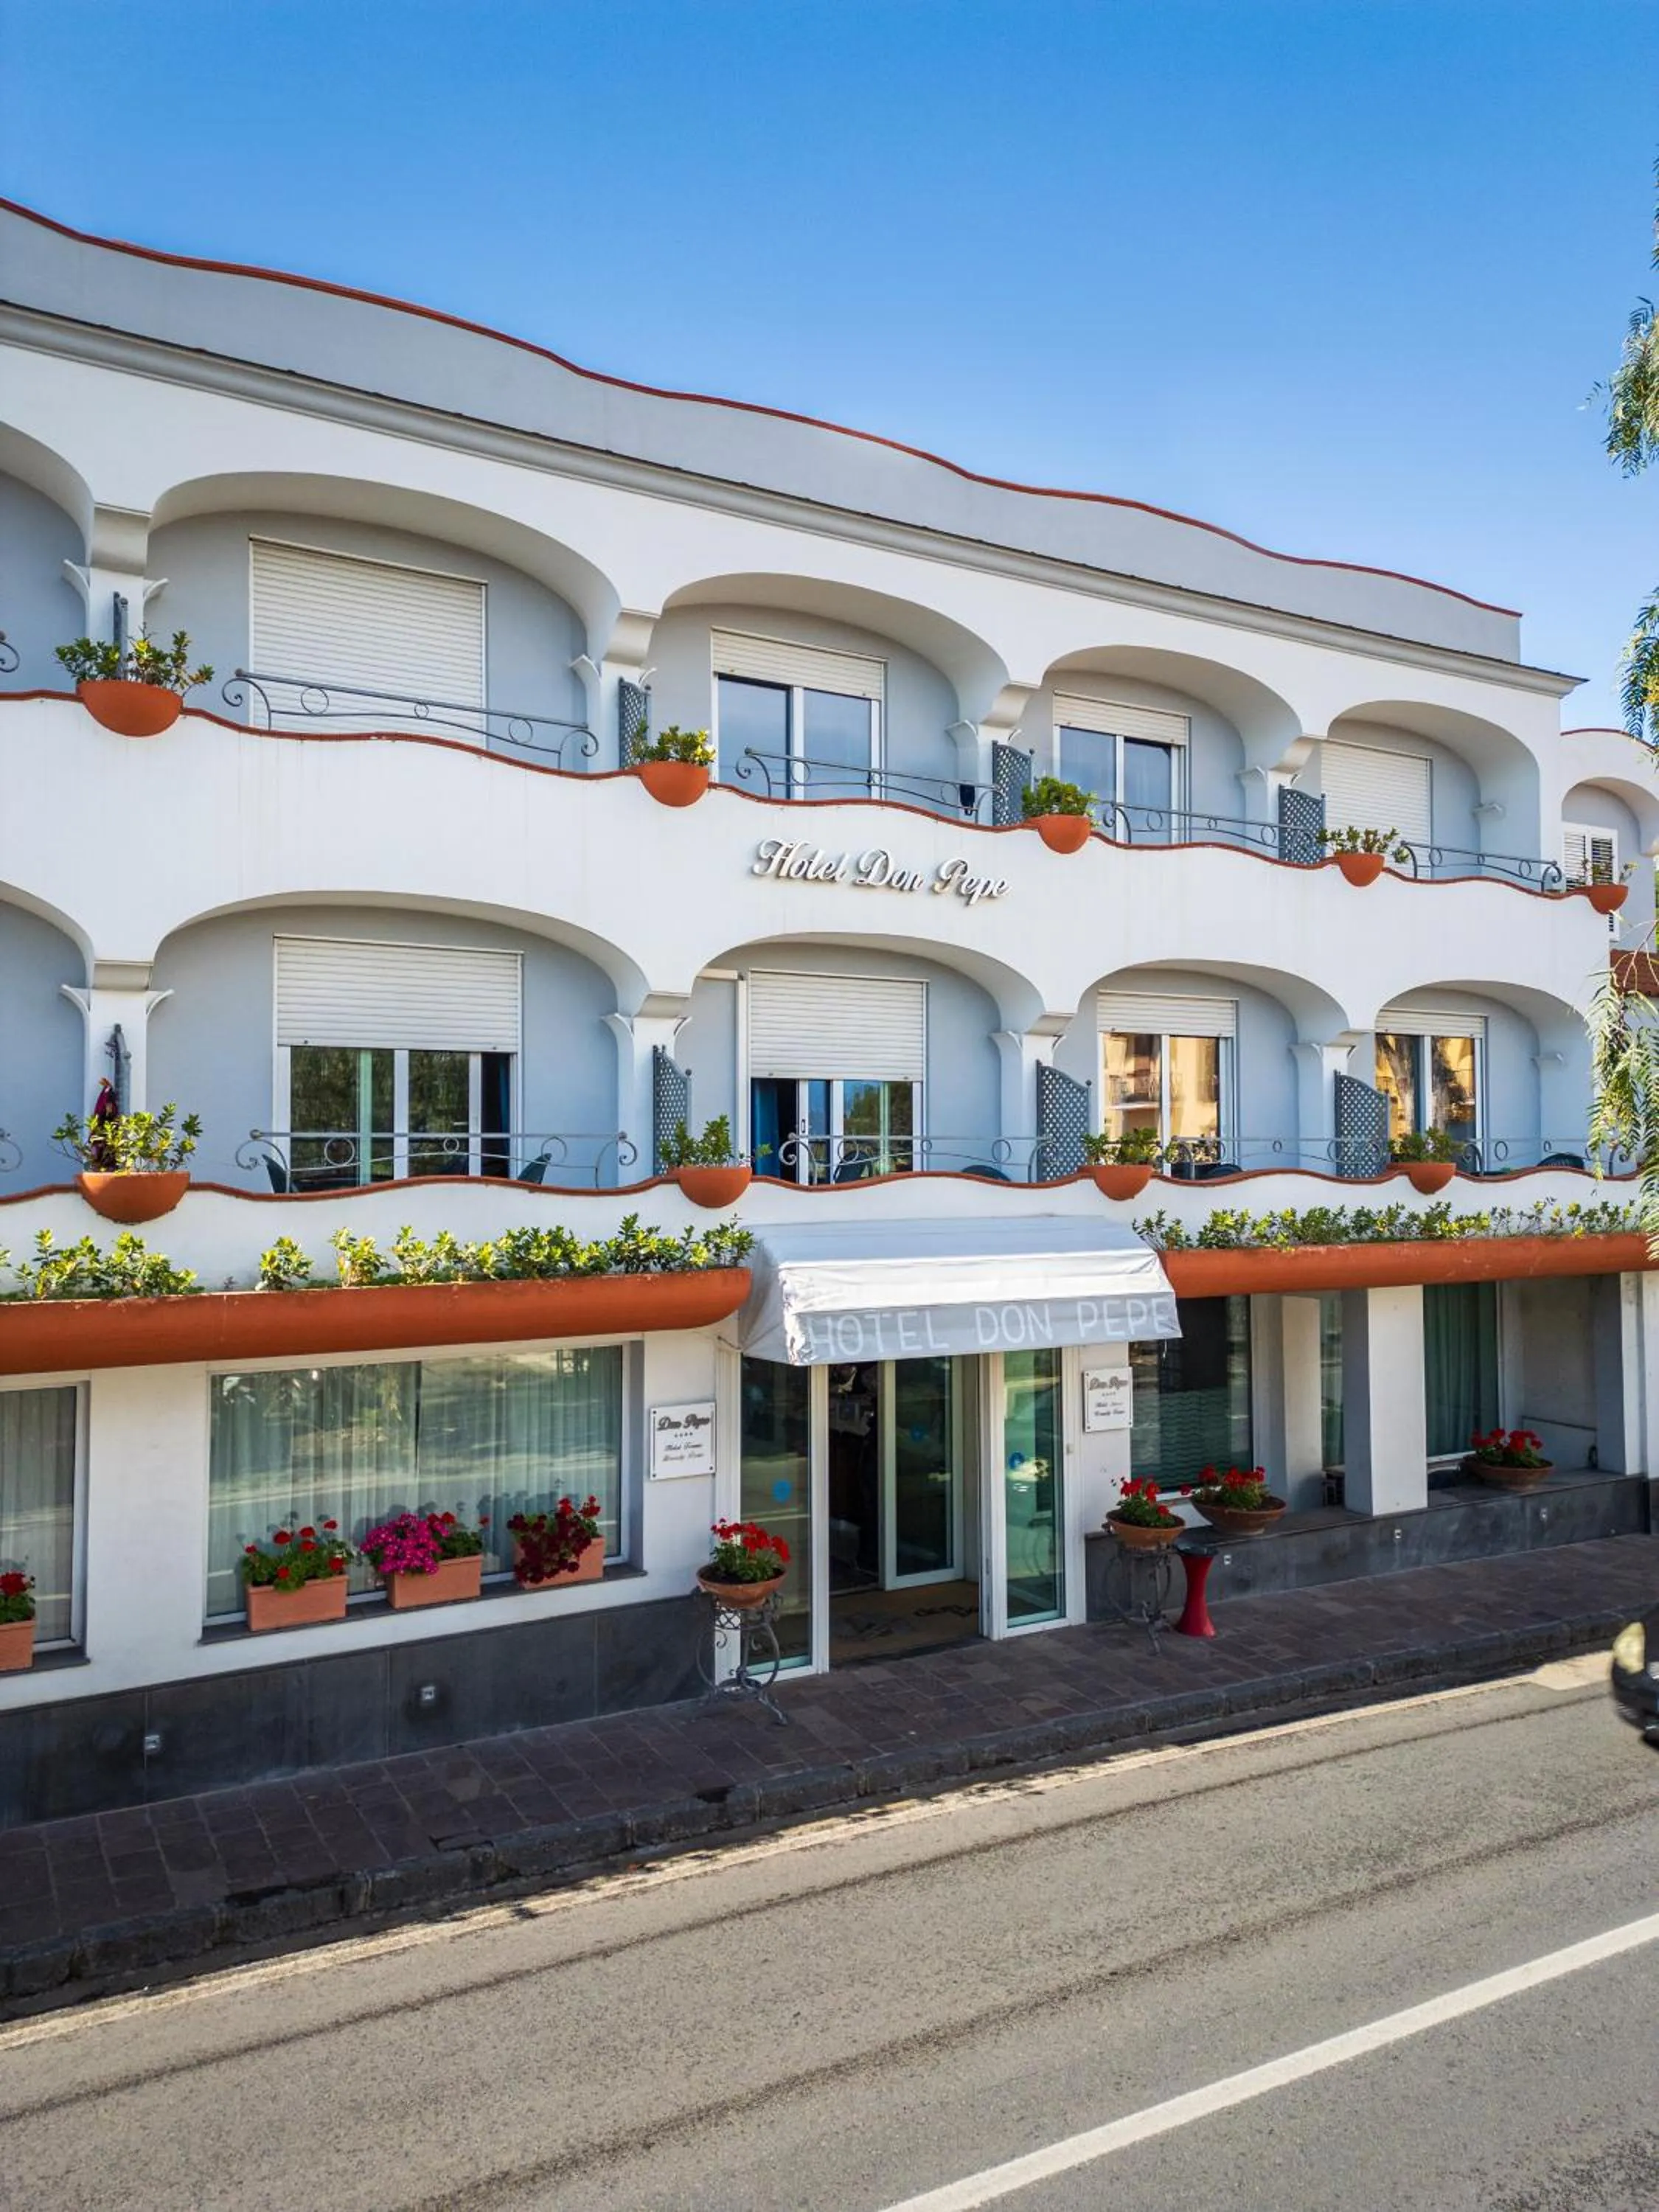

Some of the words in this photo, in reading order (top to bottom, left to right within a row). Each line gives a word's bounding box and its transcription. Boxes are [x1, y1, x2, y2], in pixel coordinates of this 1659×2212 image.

[752, 838, 849, 880] Hotel
[852, 849, 924, 891] Don
[932, 857, 1011, 905] Pepe
[807, 1310, 950, 1358] HOTEL
[975, 1304, 1054, 1345] DON
[1077, 1296, 1174, 1338] PEPE
